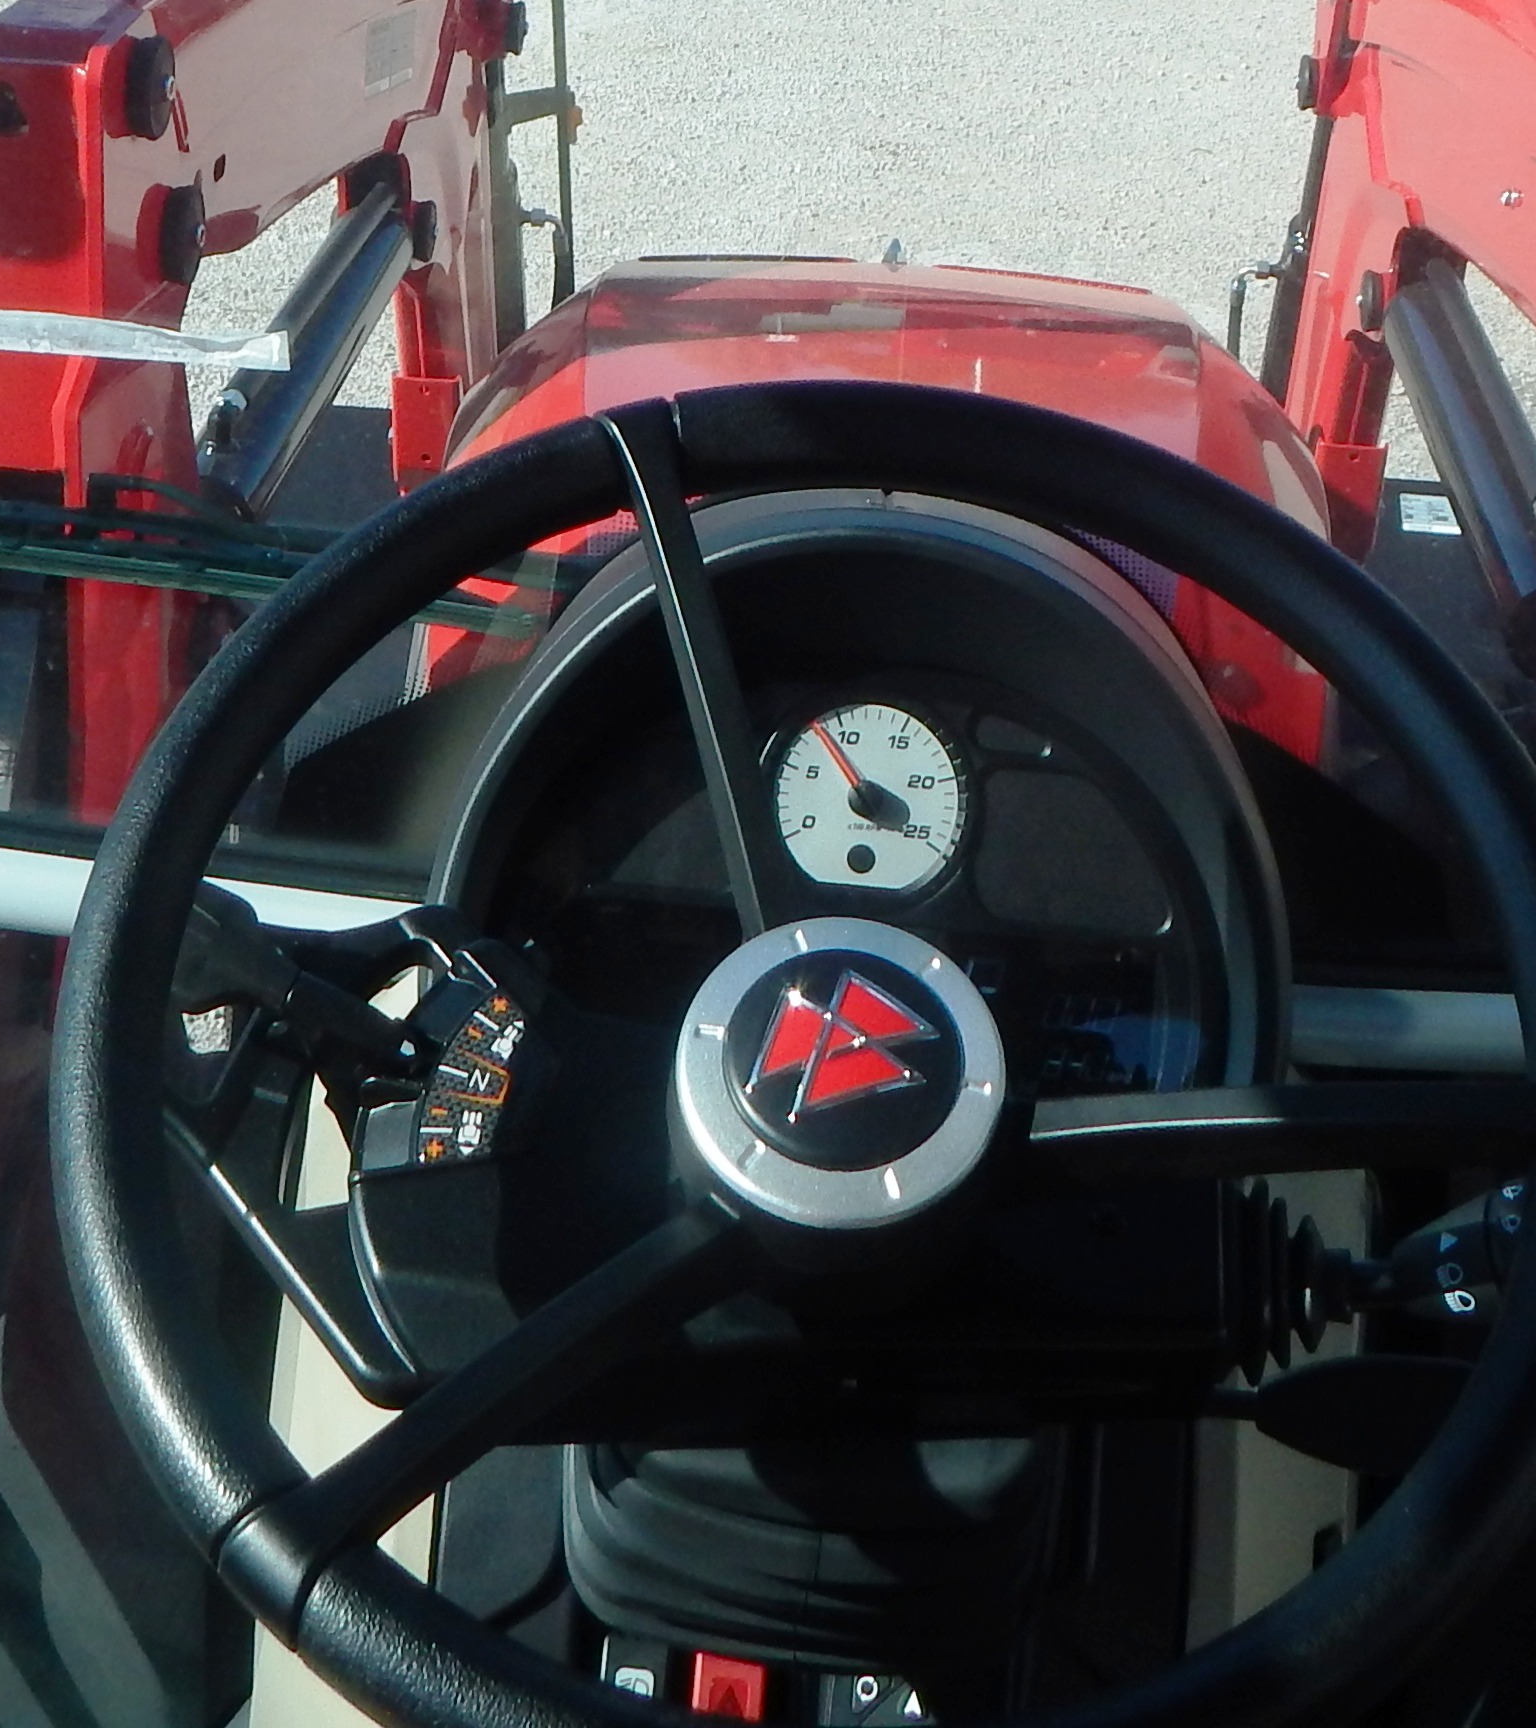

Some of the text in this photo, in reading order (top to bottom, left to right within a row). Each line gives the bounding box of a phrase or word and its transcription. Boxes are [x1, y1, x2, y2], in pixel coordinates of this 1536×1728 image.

[837, 730, 861, 745] 10
[888, 734, 911, 750] 15
[805, 765, 821, 779] 5
[907, 774, 936, 790] 20
[801, 814, 816, 829] 0
[903, 824, 932, 840] 25
[468, 1068, 491, 1092] N
